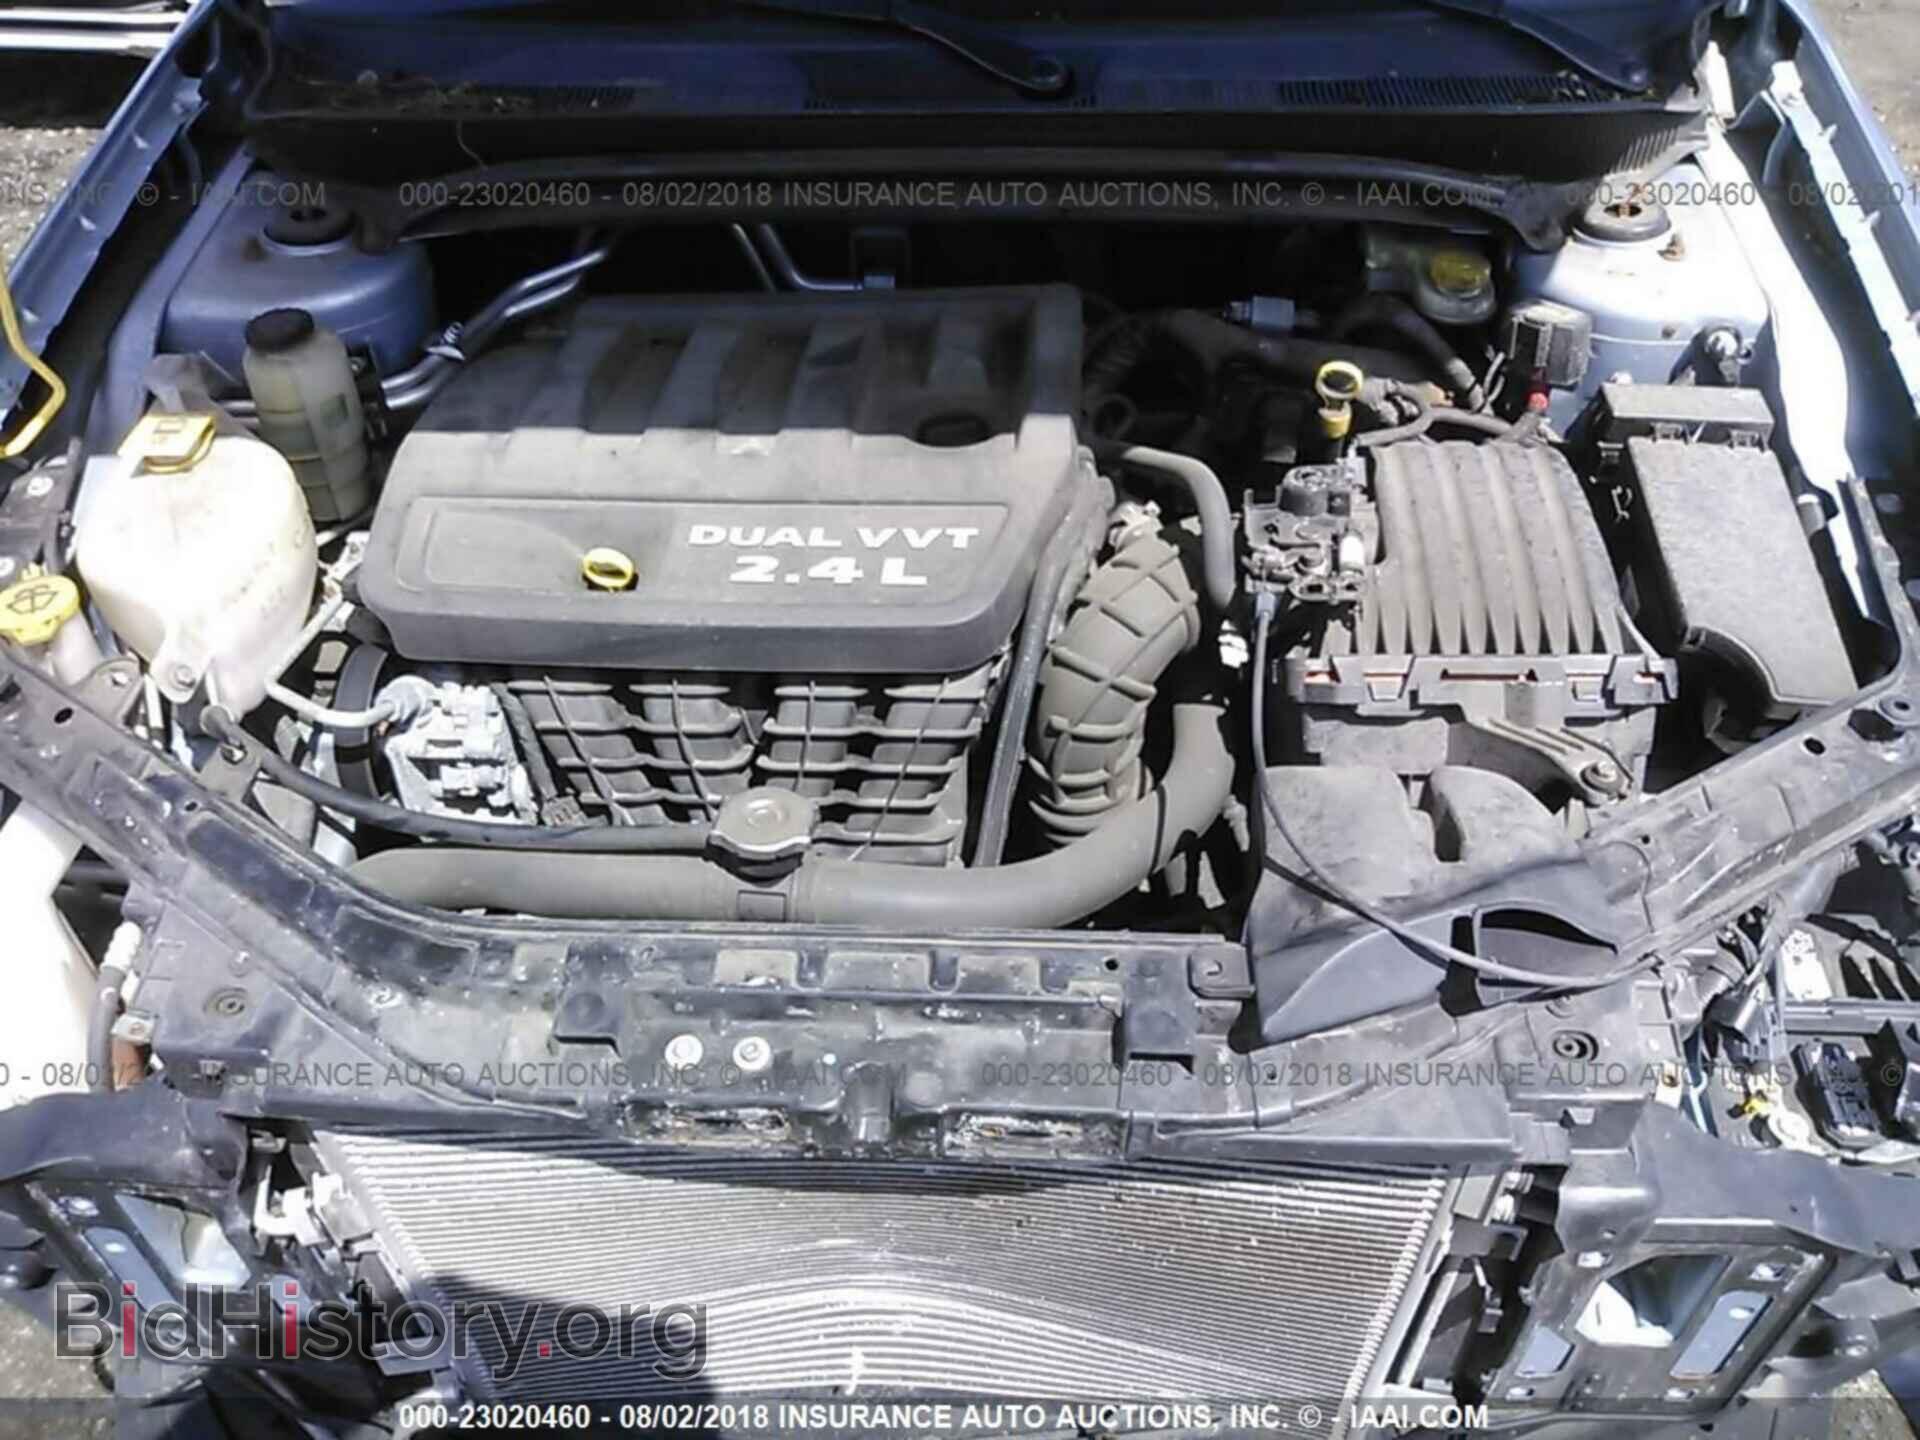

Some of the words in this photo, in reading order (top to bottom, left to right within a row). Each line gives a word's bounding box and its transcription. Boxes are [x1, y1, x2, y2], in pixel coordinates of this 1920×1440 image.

[687, 523, 842, 549] DUAL
[856, 526, 980, 549] VVT
[729, 554, 865, 585] 2.4
